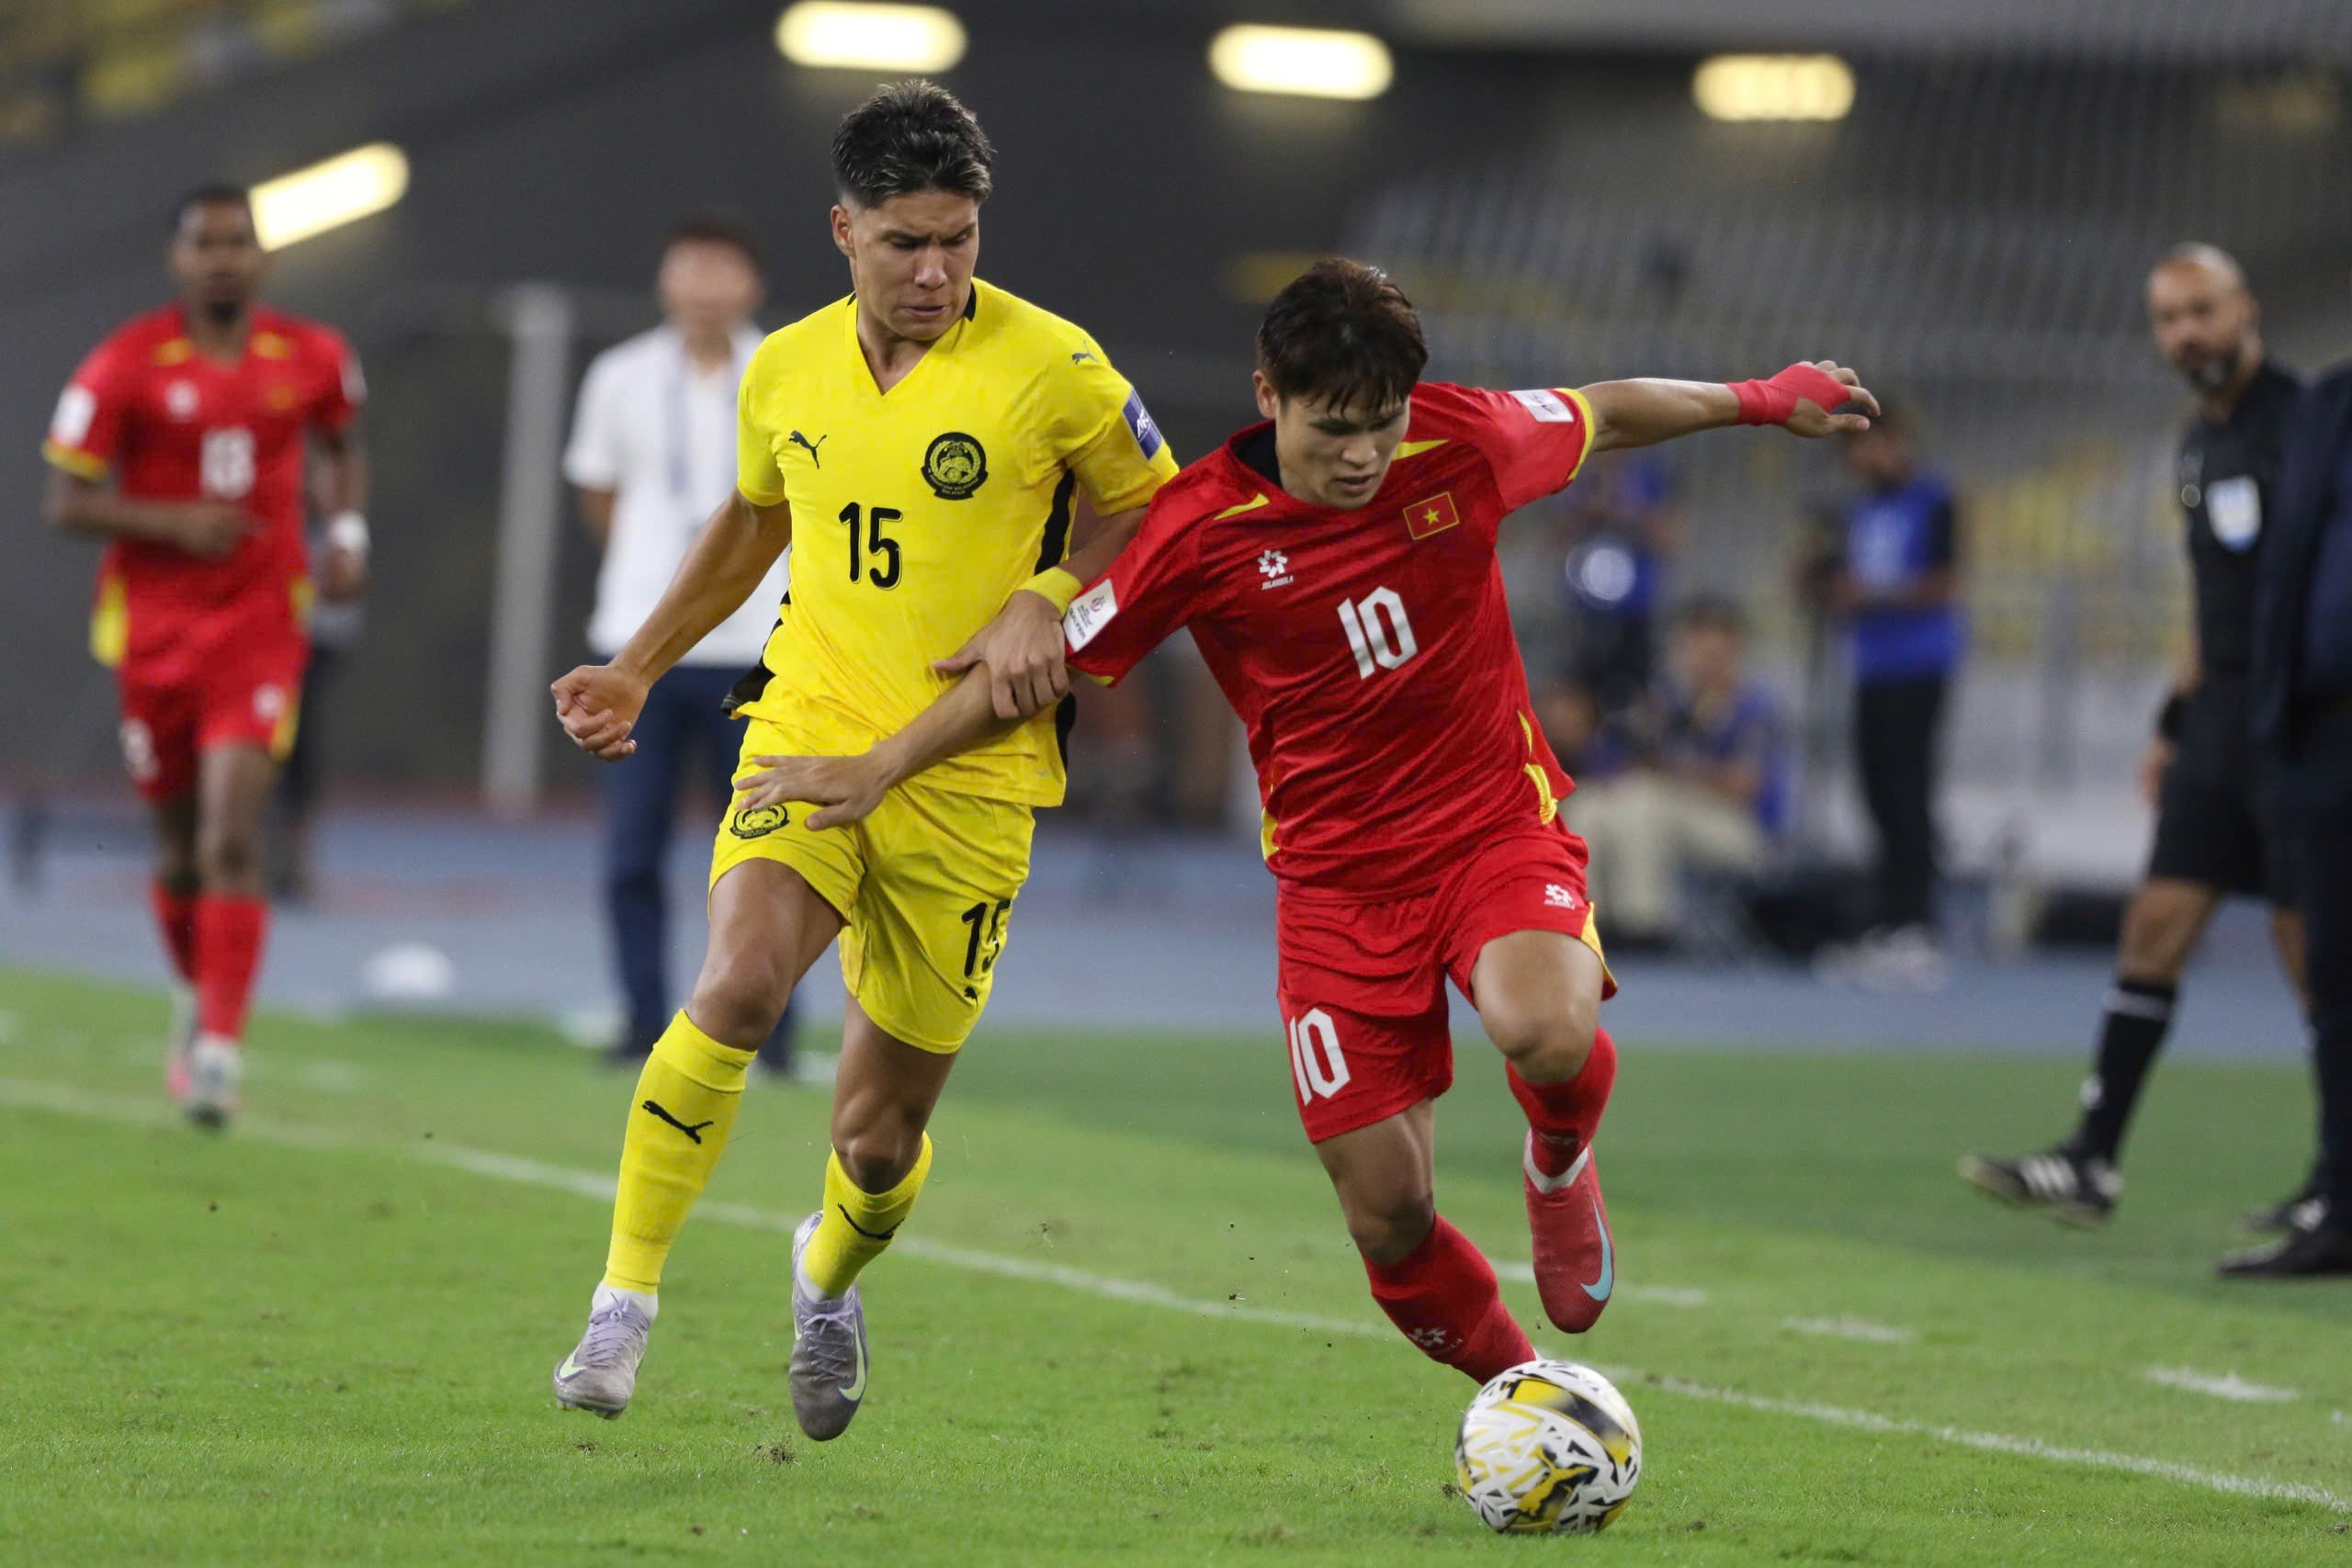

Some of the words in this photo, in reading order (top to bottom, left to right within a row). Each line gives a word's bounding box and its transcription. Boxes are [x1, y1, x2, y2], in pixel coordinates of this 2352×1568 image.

[838, 501, 903, 592] 15
[1337, 586, 1419, 681] 10
[961, 898, 1012, 980] 15
[1289, 1007, 1351, 1107] 10
